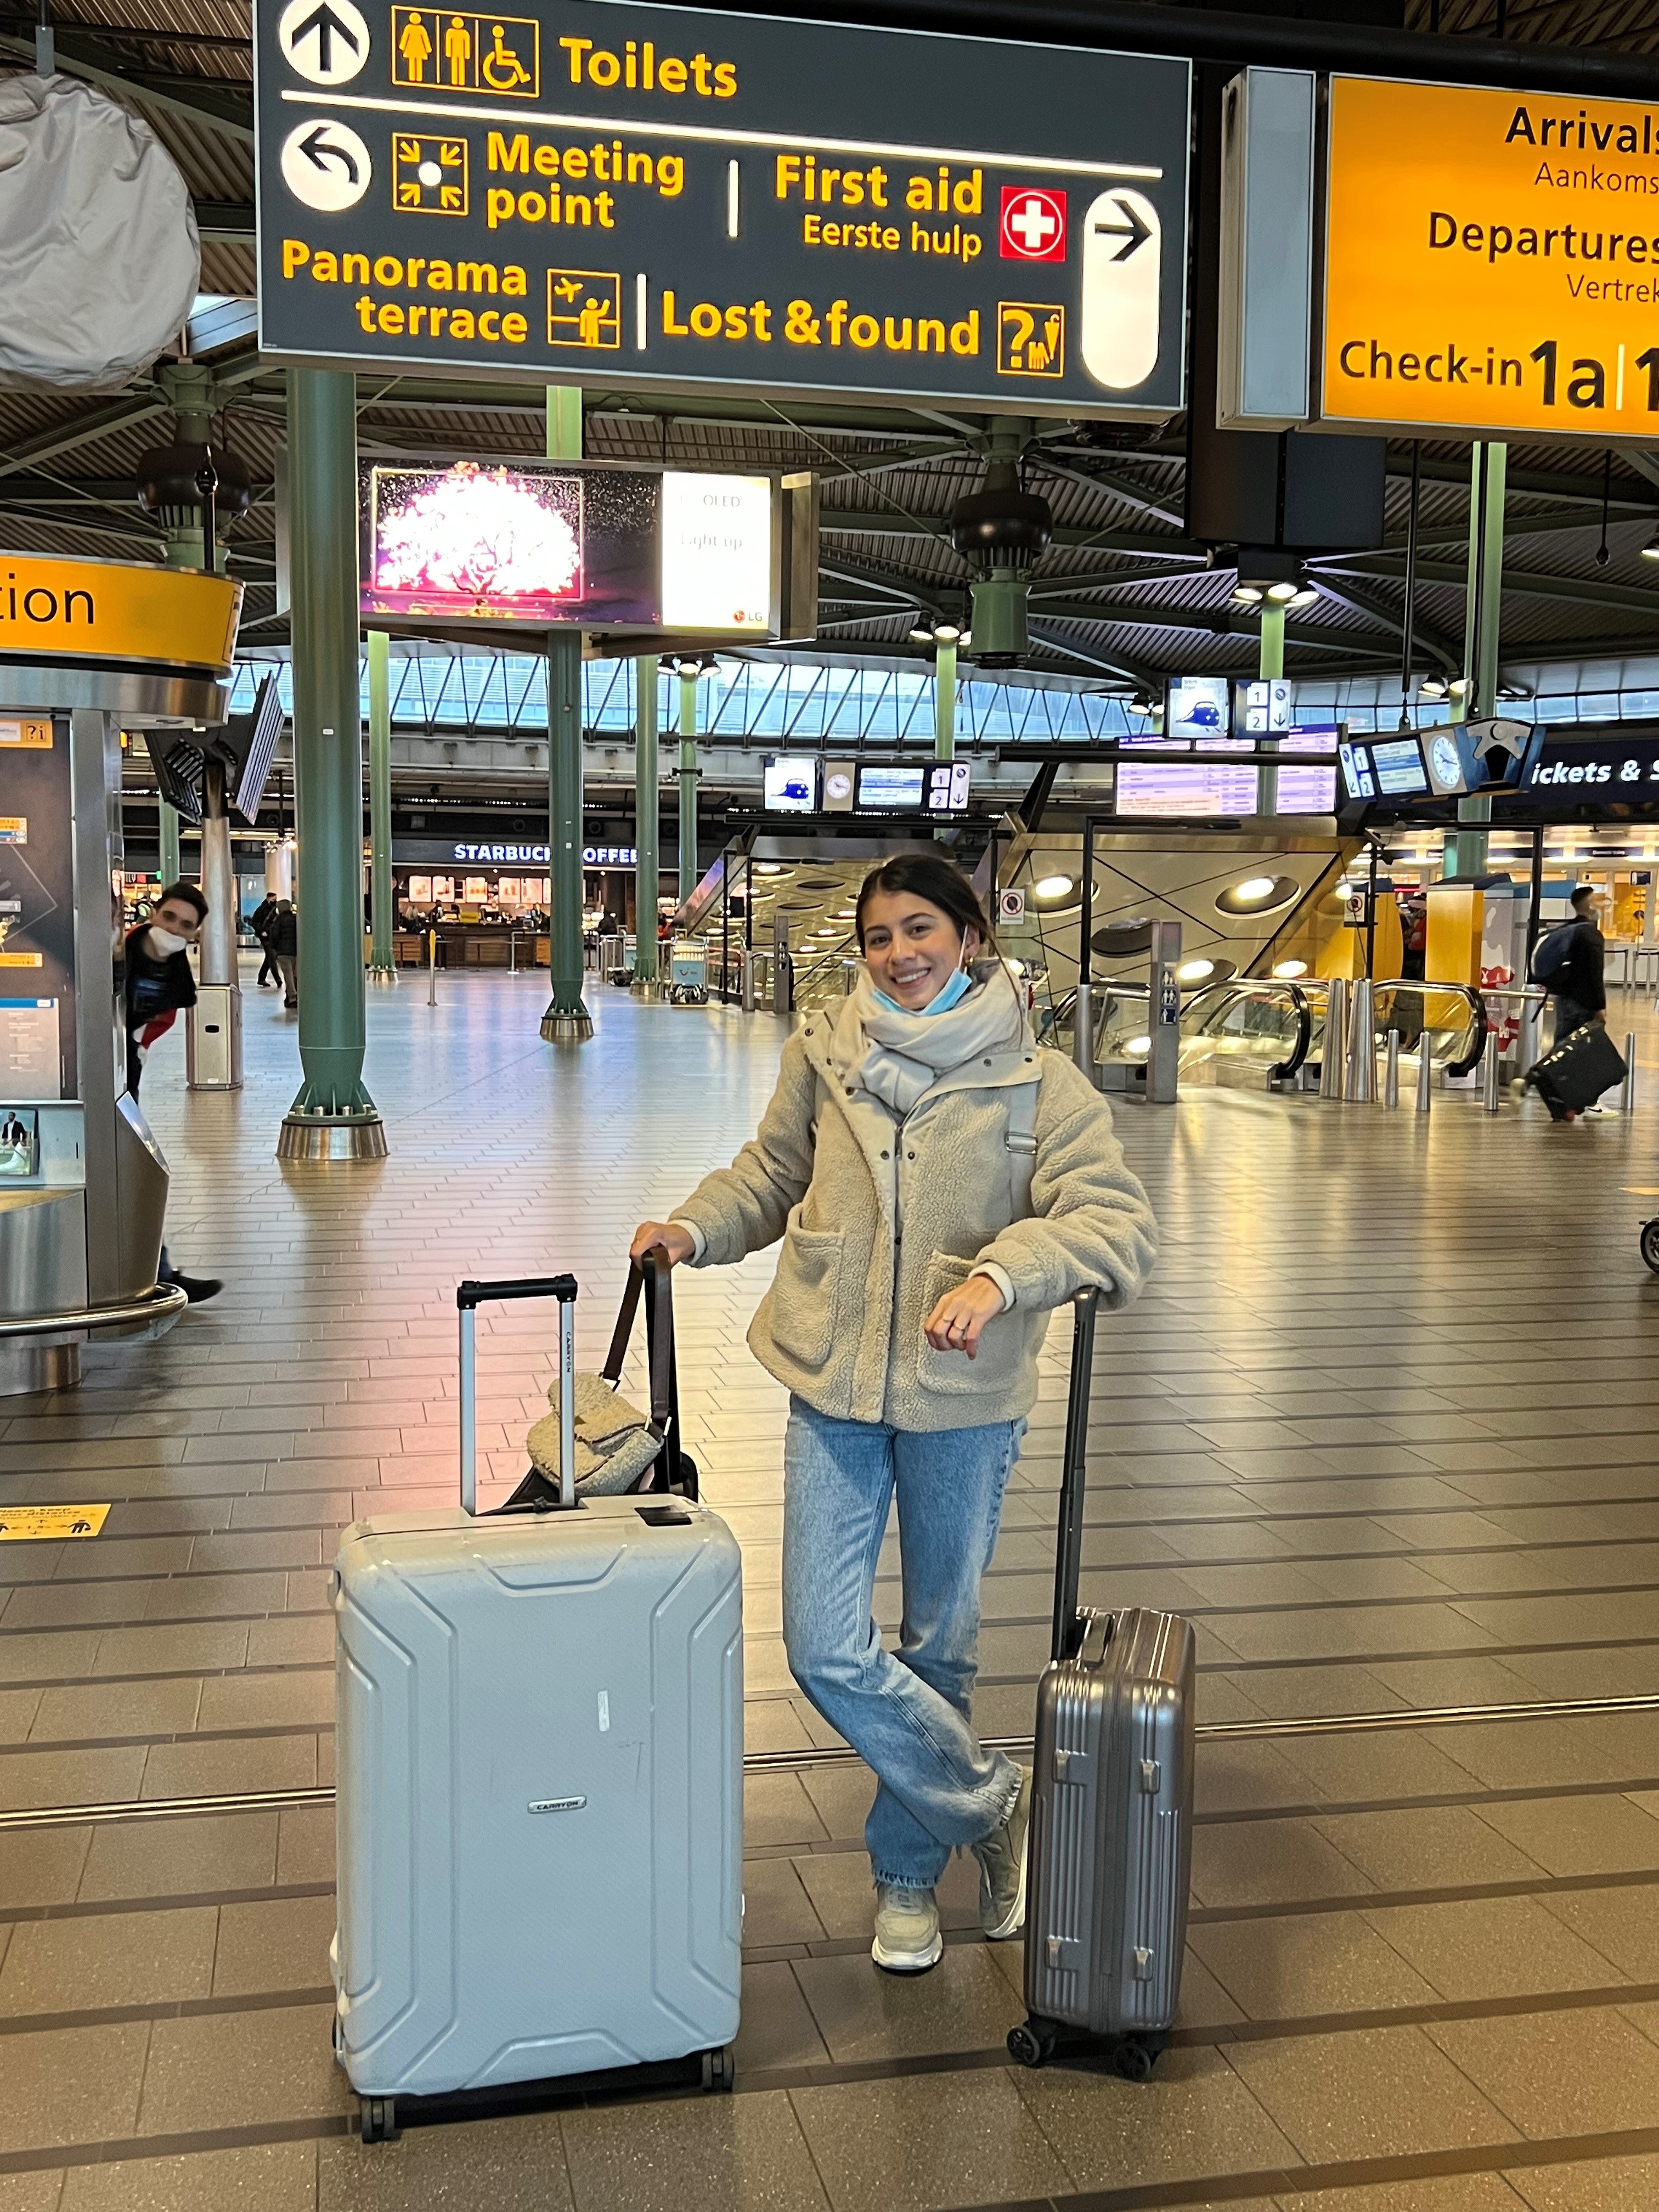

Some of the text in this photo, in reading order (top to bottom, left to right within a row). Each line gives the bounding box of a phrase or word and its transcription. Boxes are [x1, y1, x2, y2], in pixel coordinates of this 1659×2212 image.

[558, 36, 738, 98] Toilets
[1505, 106, 1659, 156] Arrival
[486, 130, 685, 198] Meeting
[775, 154, 983, 216] First aid
[486, 182, 615, 230] point
[803, 215, 983, 264] Eerste hulp
[281, 239, 528, 297] Panorama
[354, 295, 529, 345] terrace
[662, 290, 772, 343] Lost
[1340, 340, 1522, 386] Check-in
[1530, 340, 1605, 409] 1a
[703, 494, 741, 508] OLED
[0, 572, 94, 624] ion
[748, 612, 763, 622] LG
[1254, 691, 1260, 703] 1
[1252, 716, 1261, 729] 2
[938, 775, 944, 785] 1
[1531, 761, 1612, 785] ickets
[1620, 759, 1641, 782] &
[935, 795, 941, 806] 2
[582, 847, 638, 864] OFFEE
[537, 1801, 578, 1810] CARRYON
